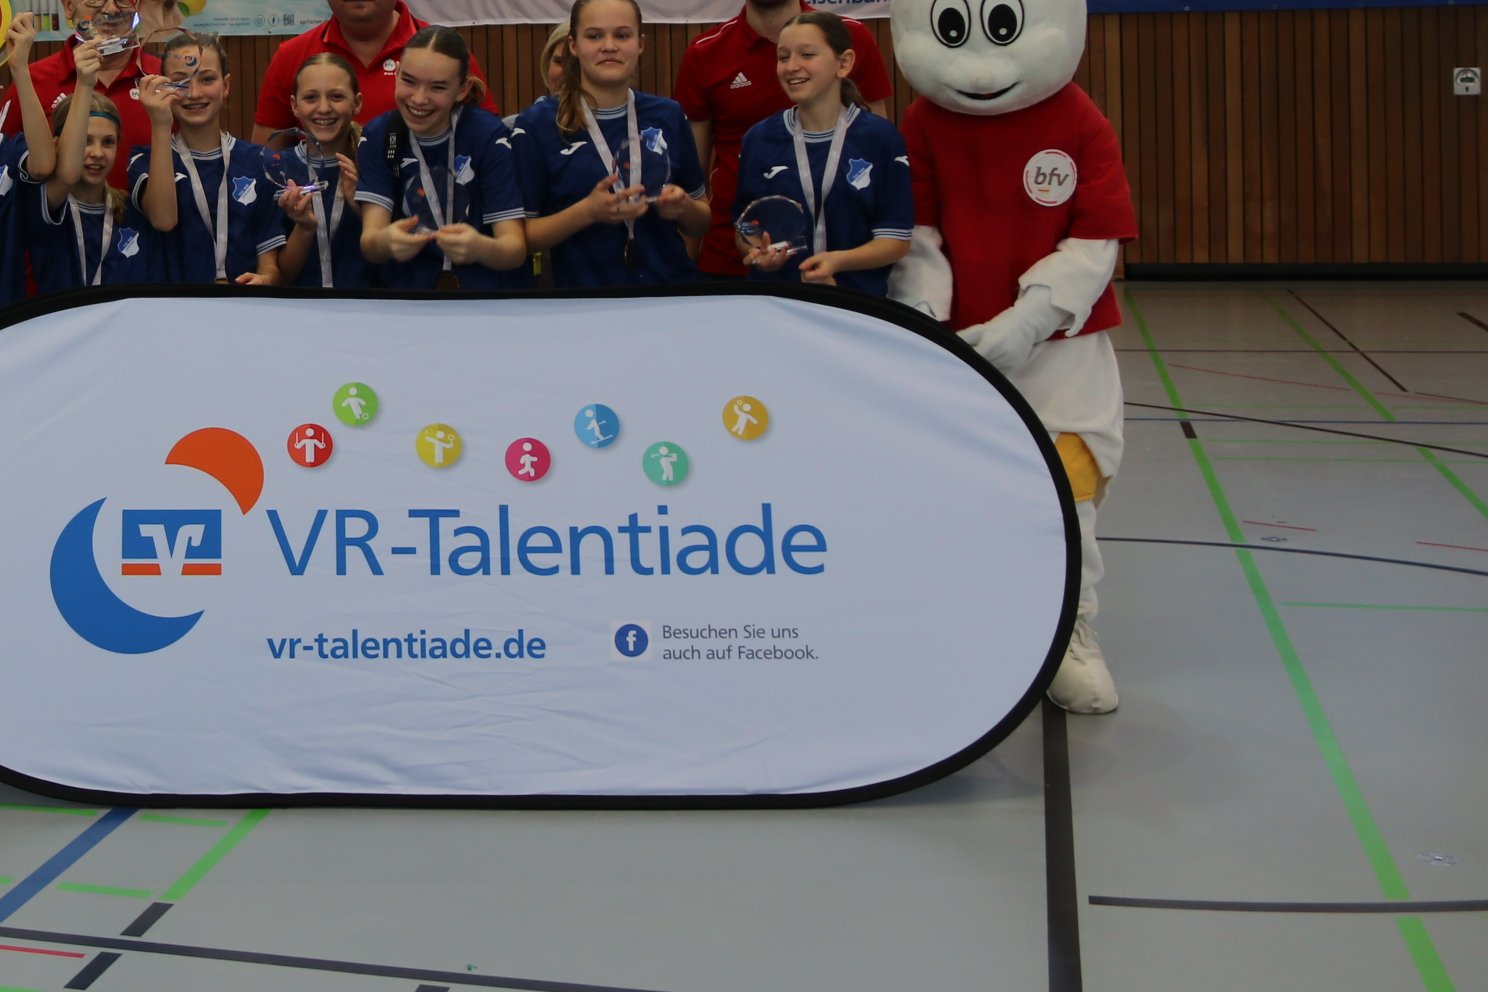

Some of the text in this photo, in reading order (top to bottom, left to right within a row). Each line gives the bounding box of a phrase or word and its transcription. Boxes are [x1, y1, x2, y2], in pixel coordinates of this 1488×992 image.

[730, 80, 752, 89] adidas
[1033, 166, 1070, 187] bfv
[265, 502, 829, 577] VR-Talentiade
[662, 624, 800, 641] Besuchen Sie uns
[266, 628, 548, 660] vr-talentiade.de
[662, 644, 820, 661] auch auf Facebook.
